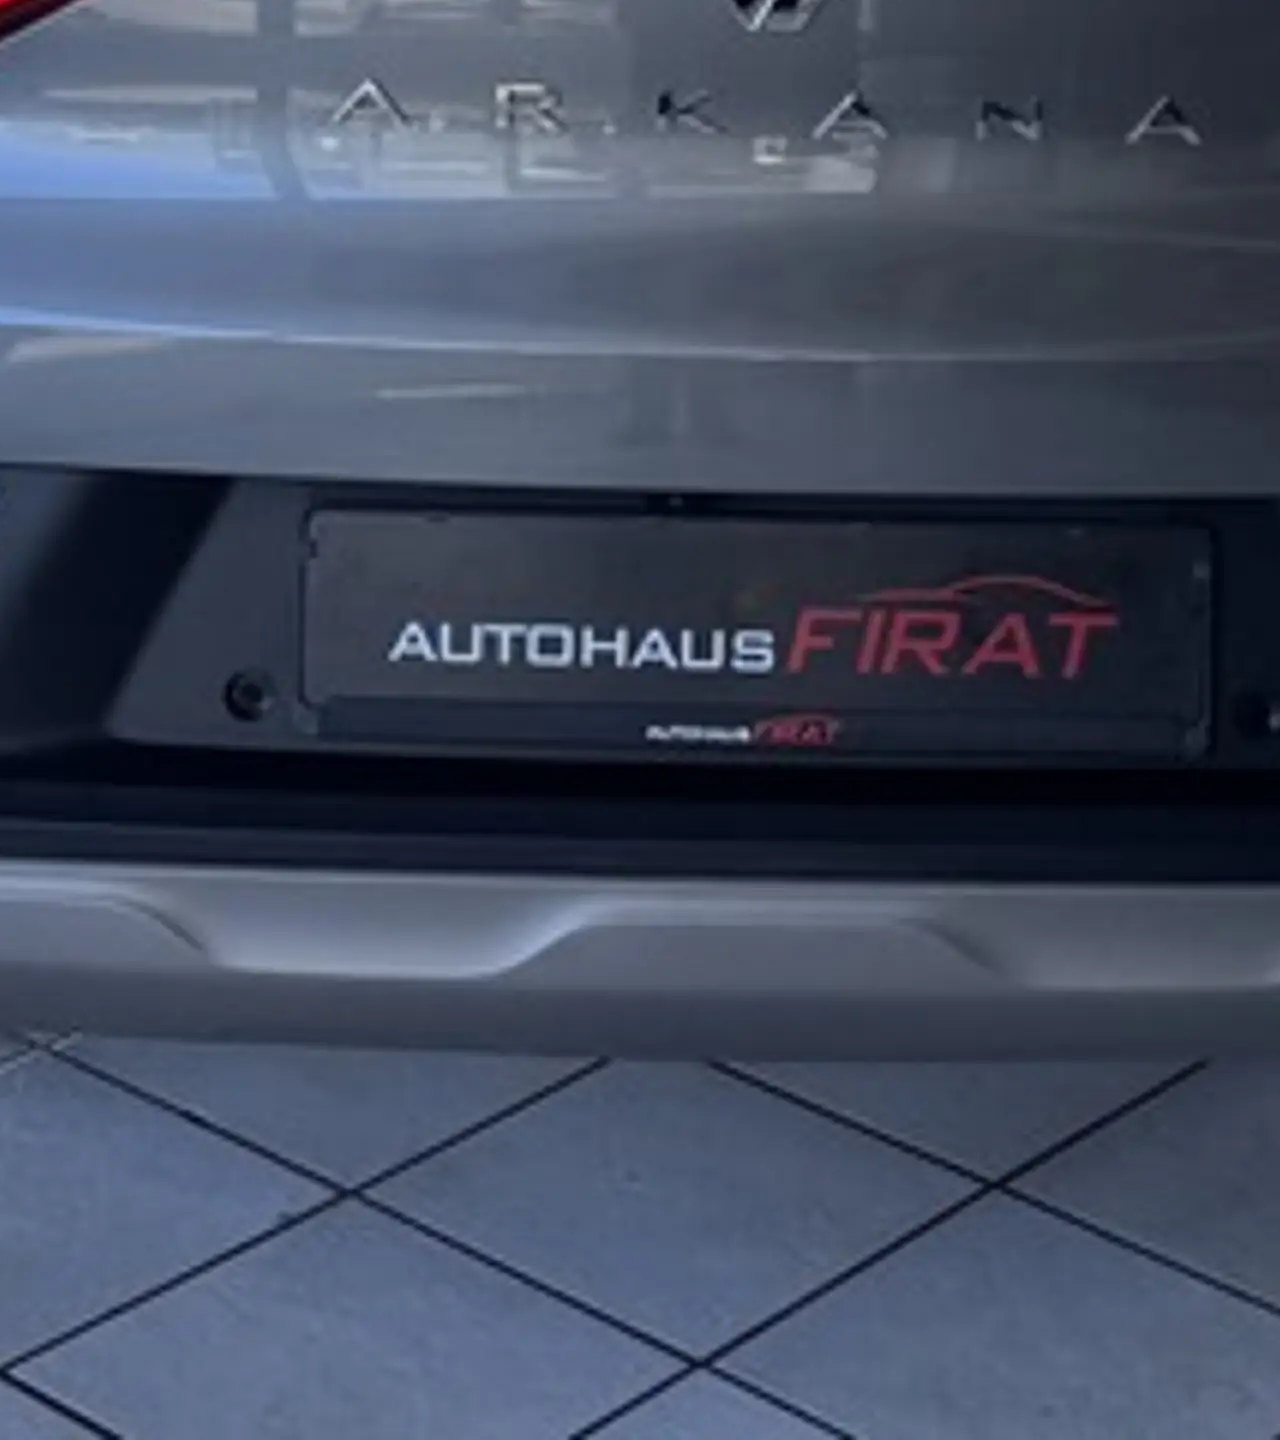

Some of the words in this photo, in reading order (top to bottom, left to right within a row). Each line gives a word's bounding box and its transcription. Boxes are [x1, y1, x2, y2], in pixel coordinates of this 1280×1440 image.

[331, 76, 1202, 146] ARKANA
[388, 621, 776, 674] AUTOHAUS
[785, 607, 1118, 679] FIRAT
